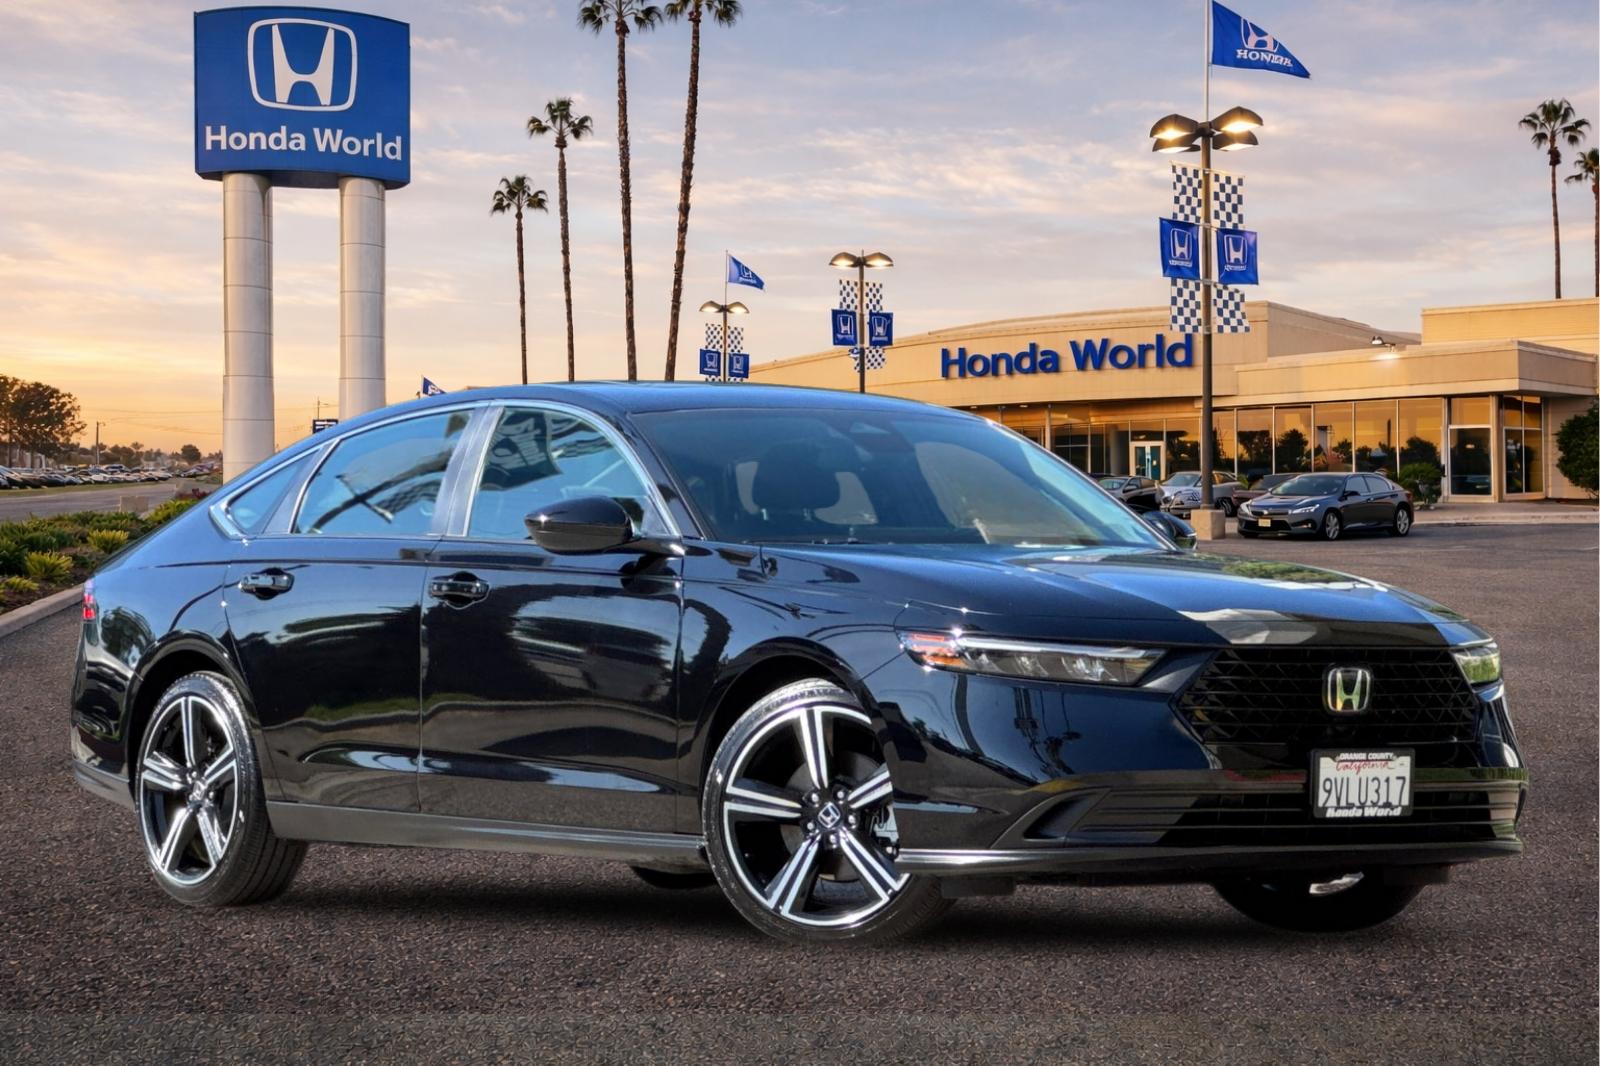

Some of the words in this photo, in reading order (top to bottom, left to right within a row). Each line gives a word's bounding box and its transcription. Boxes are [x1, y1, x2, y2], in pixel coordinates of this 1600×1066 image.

[205, 125, 305, 151] Honda
[312, 127, 402, 161] World
[941, 342, 1060, 379] Honda
[1069, 333, 1194, 371] World
[1322, 776, 1406, 807] 9VLU317
